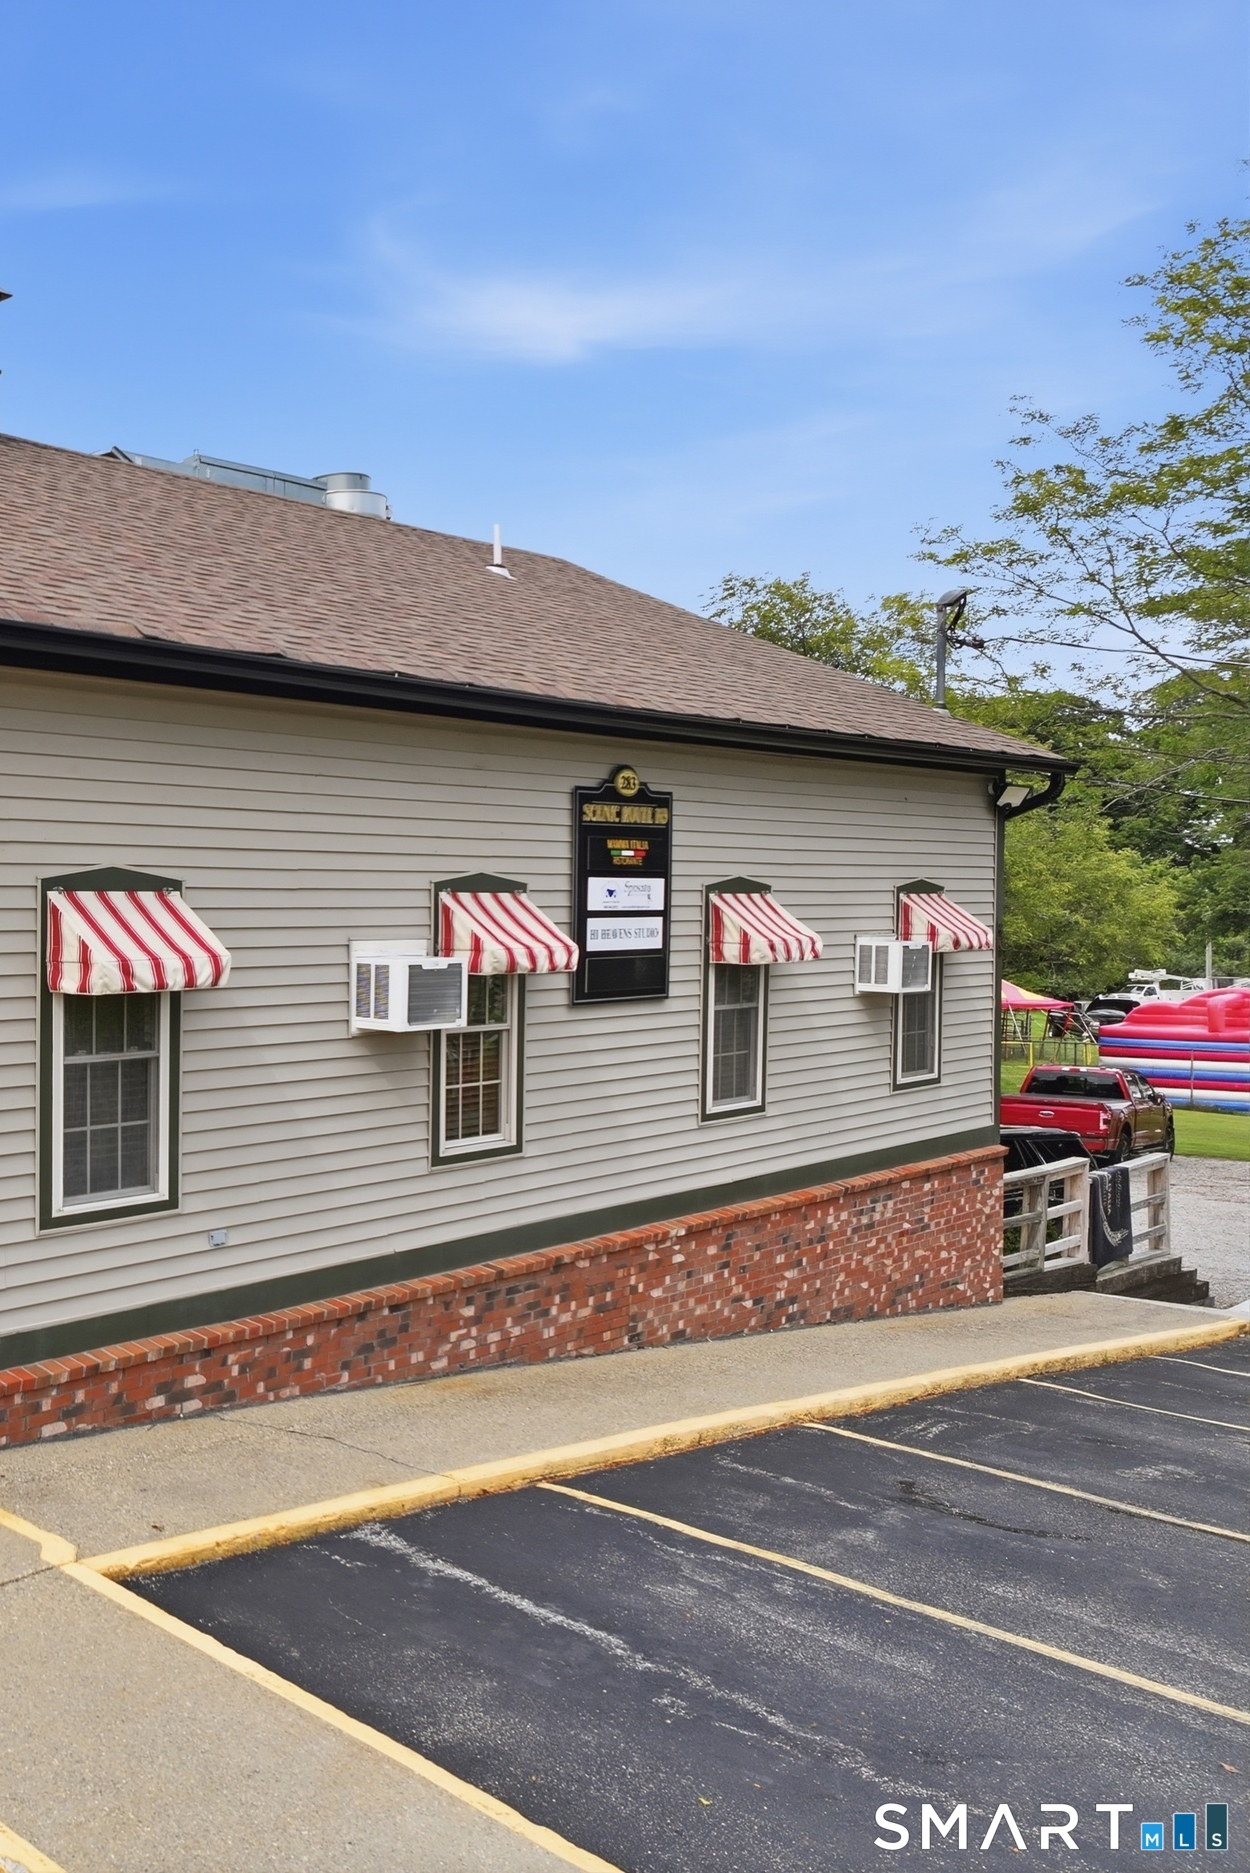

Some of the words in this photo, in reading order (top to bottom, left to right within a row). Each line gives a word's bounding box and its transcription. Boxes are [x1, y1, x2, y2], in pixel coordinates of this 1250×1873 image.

[582, 803, 620, 822] SCENIC
[600, 928, 632, 939] HEAVENS
[633, 927, 659, 938] STUDIO
